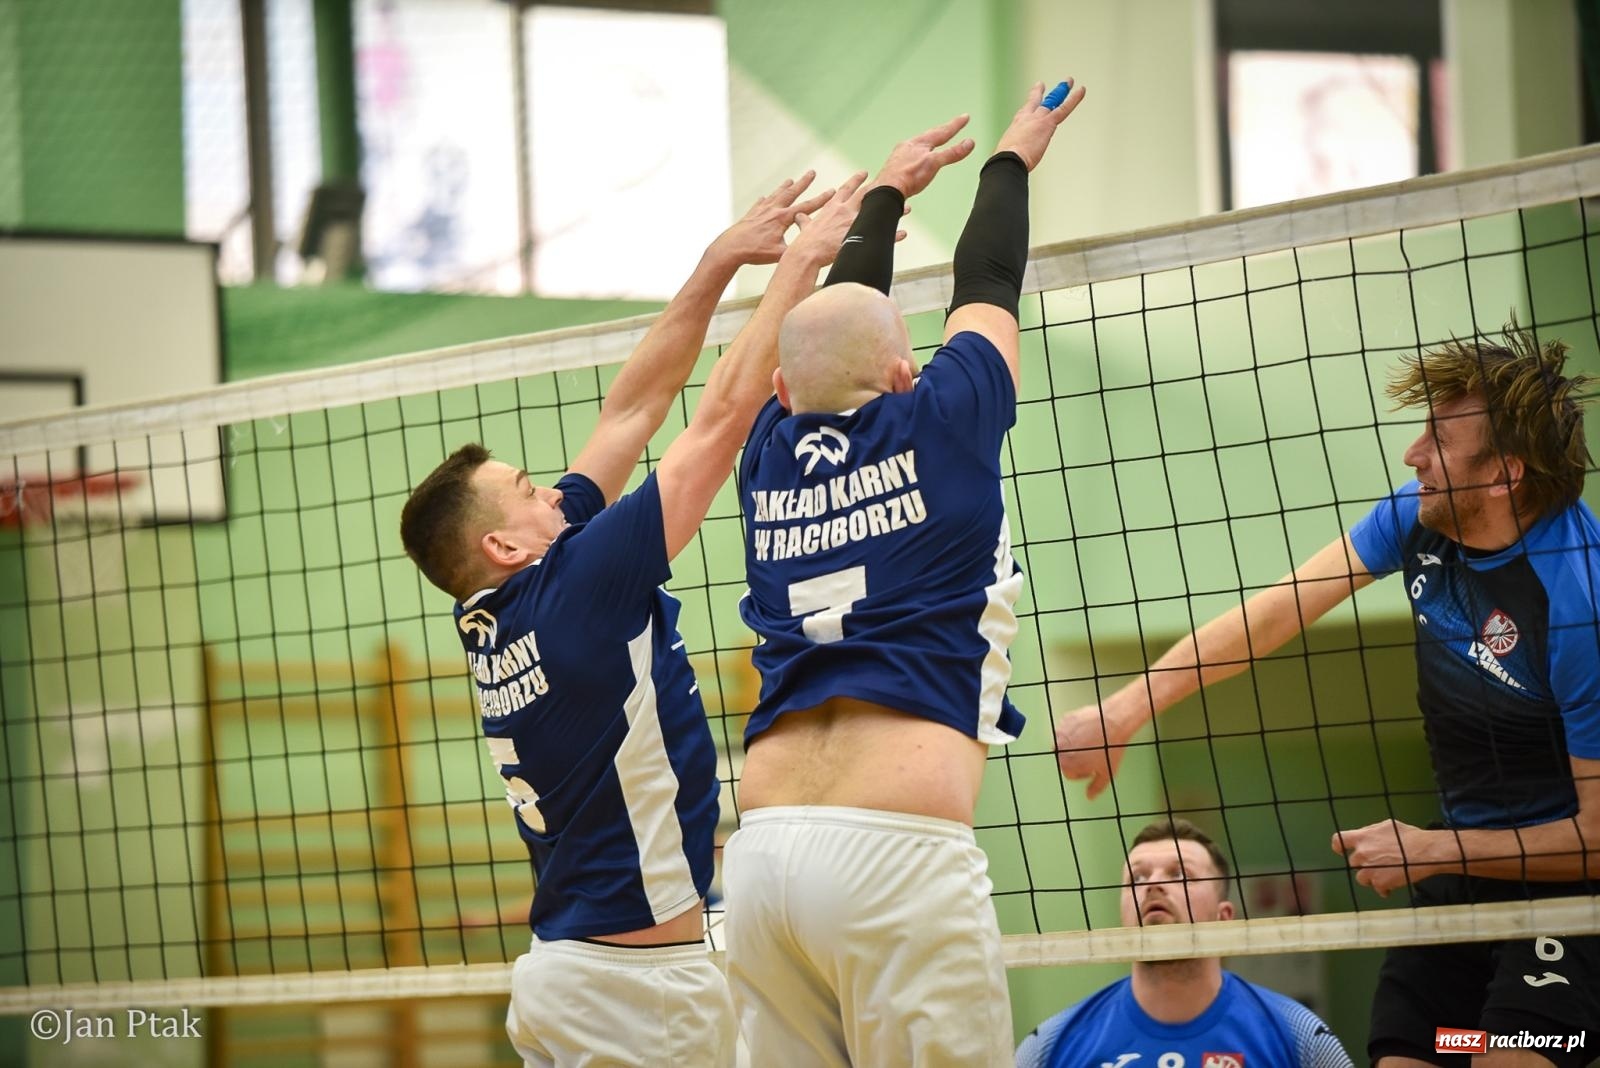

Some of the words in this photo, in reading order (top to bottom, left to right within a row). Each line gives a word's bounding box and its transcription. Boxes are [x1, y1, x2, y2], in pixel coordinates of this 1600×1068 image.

[829, 450, 918, 511] KARNY
[754, 529, 771, 561] W
[772, 489, 927, 561] RACIBORZU
[788, 565, 867, 644] 7
[1410, 574, 1427, 600] 6
